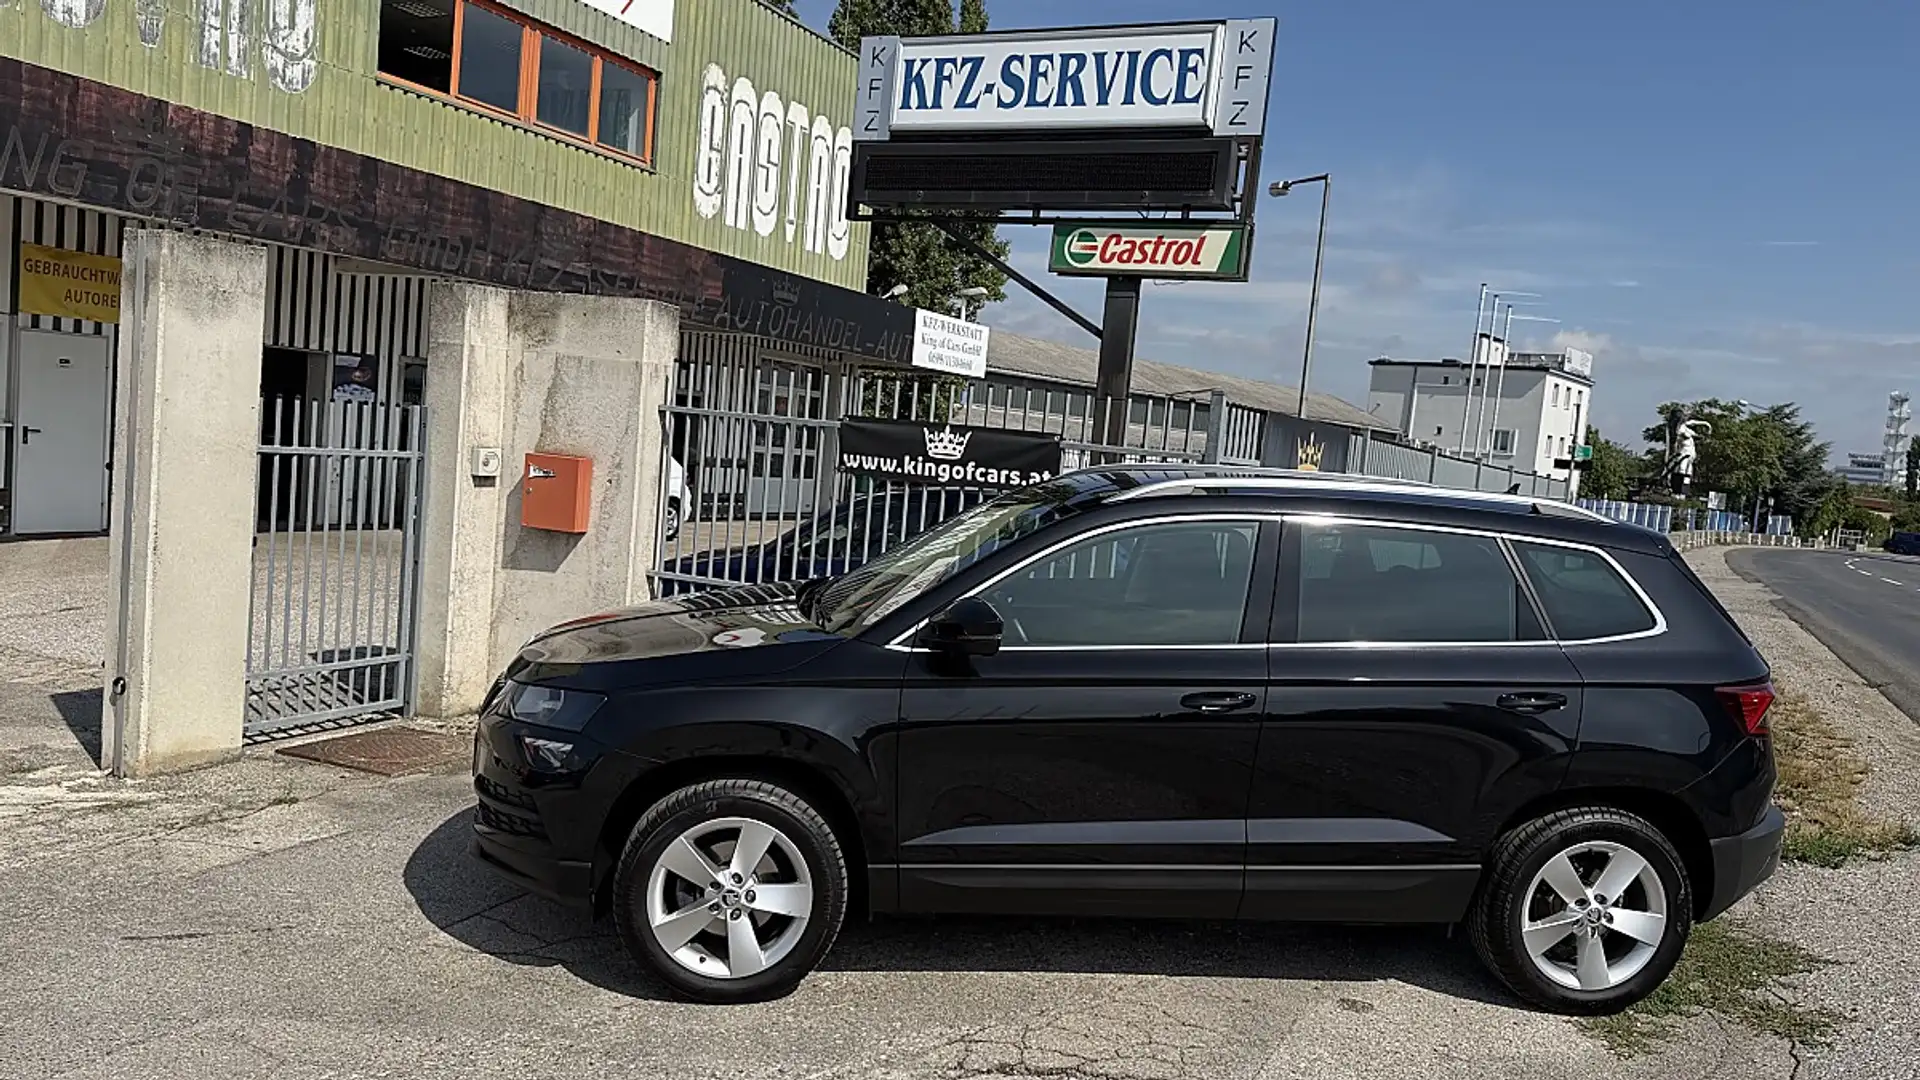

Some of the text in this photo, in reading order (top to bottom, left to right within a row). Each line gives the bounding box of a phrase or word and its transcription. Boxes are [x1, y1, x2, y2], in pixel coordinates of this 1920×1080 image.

[864, 46, 886, 132] KFZ
[899, 48, 1206, 110] KFZ-SERVICE
[1229, 30, 1258, 125] KFZ
[1100, 233, 1207, 266] Castrol
[24, 258, 121, 286] GEBRAUCHTW
[64, 288, 121, 309] AUTORE
[921, 332, 938, 350] King
[843, 454, 1052, 486] www.kingofcars.at
